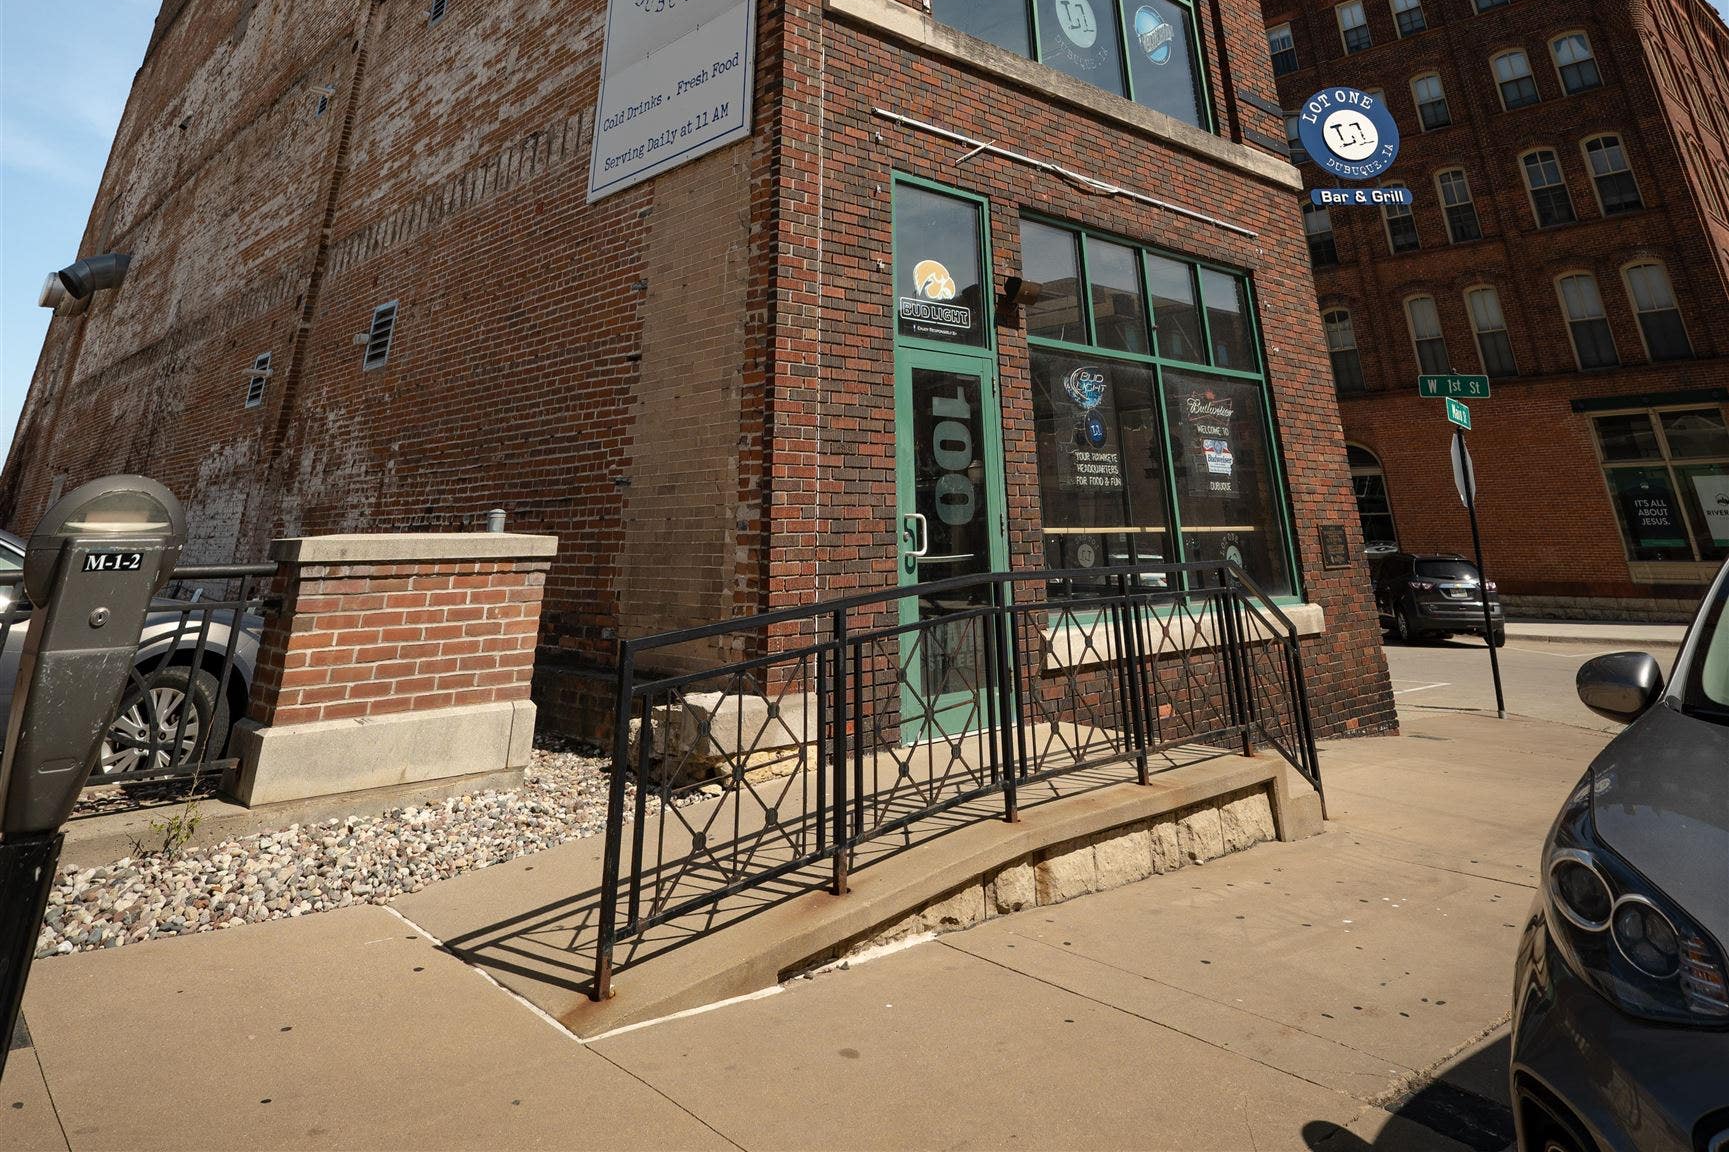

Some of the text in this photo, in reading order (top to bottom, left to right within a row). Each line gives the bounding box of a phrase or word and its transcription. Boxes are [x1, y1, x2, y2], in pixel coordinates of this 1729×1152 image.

[603, 111, 624, 132] Cold
[627, 94, 663, 121] Drinks
[676, 69, 709, 96] Fresh
[712, 52, 739, 78] Food
[1302, 90, 1373, 124] LOT ONE
[604, 102, 729, 171] Serving Daily at 11 AM
[1326, 158, 1382, 176] DUBUQUE
[1382, 144, 1394, 157] IA
[1321, 190, 1404, 203] Bar & Grill
[903, 302, 968, 324] BUD LIGHT
[1080, 371, 1103, 383] BUD
[1427, 379, 1481, 394] W 1st St
[932, 386, 976, 526] 100
[1076, 476, 1087, 486] FOR
[1089, 477, 1104, 486] FOOD
[1635, 499, 1667, 507] IT'S ALL
[1638, 508, 1668, 516] ABOUT
[1642, 517, 1671, 526] JESUS.
[84, 553, 141, 571] M-1-2
